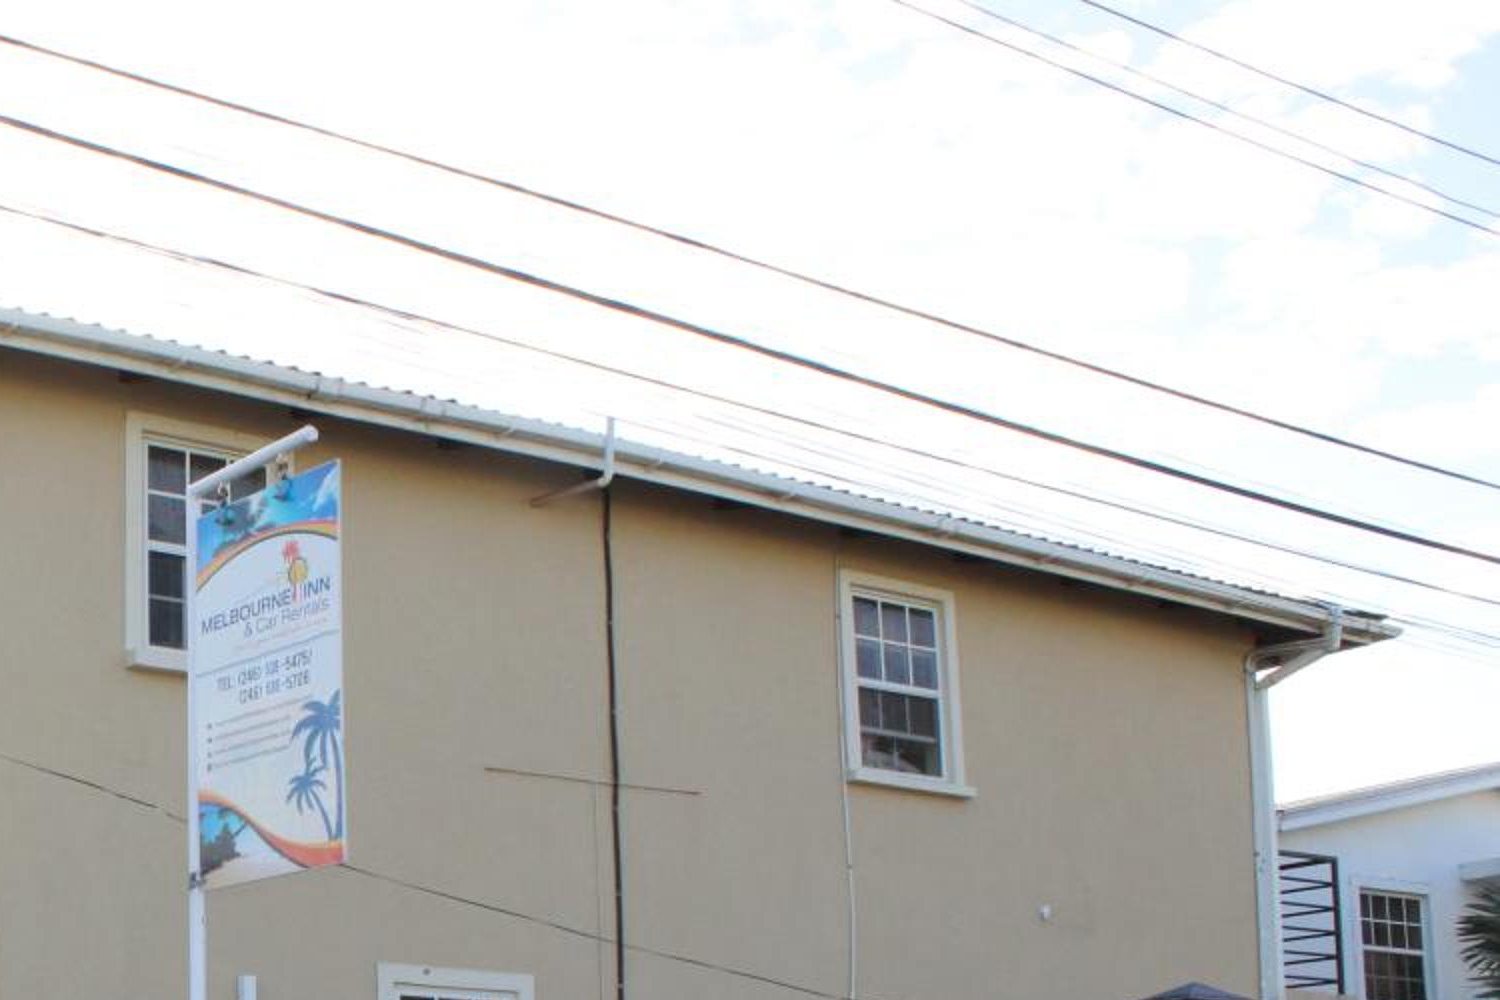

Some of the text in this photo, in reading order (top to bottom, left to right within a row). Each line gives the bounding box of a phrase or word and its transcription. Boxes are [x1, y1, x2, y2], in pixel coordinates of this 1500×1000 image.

[201, 588, 291, 636] MELBOURNE
[304, 576, 330, 599] INN
[256, 616, 277, 633] Car
